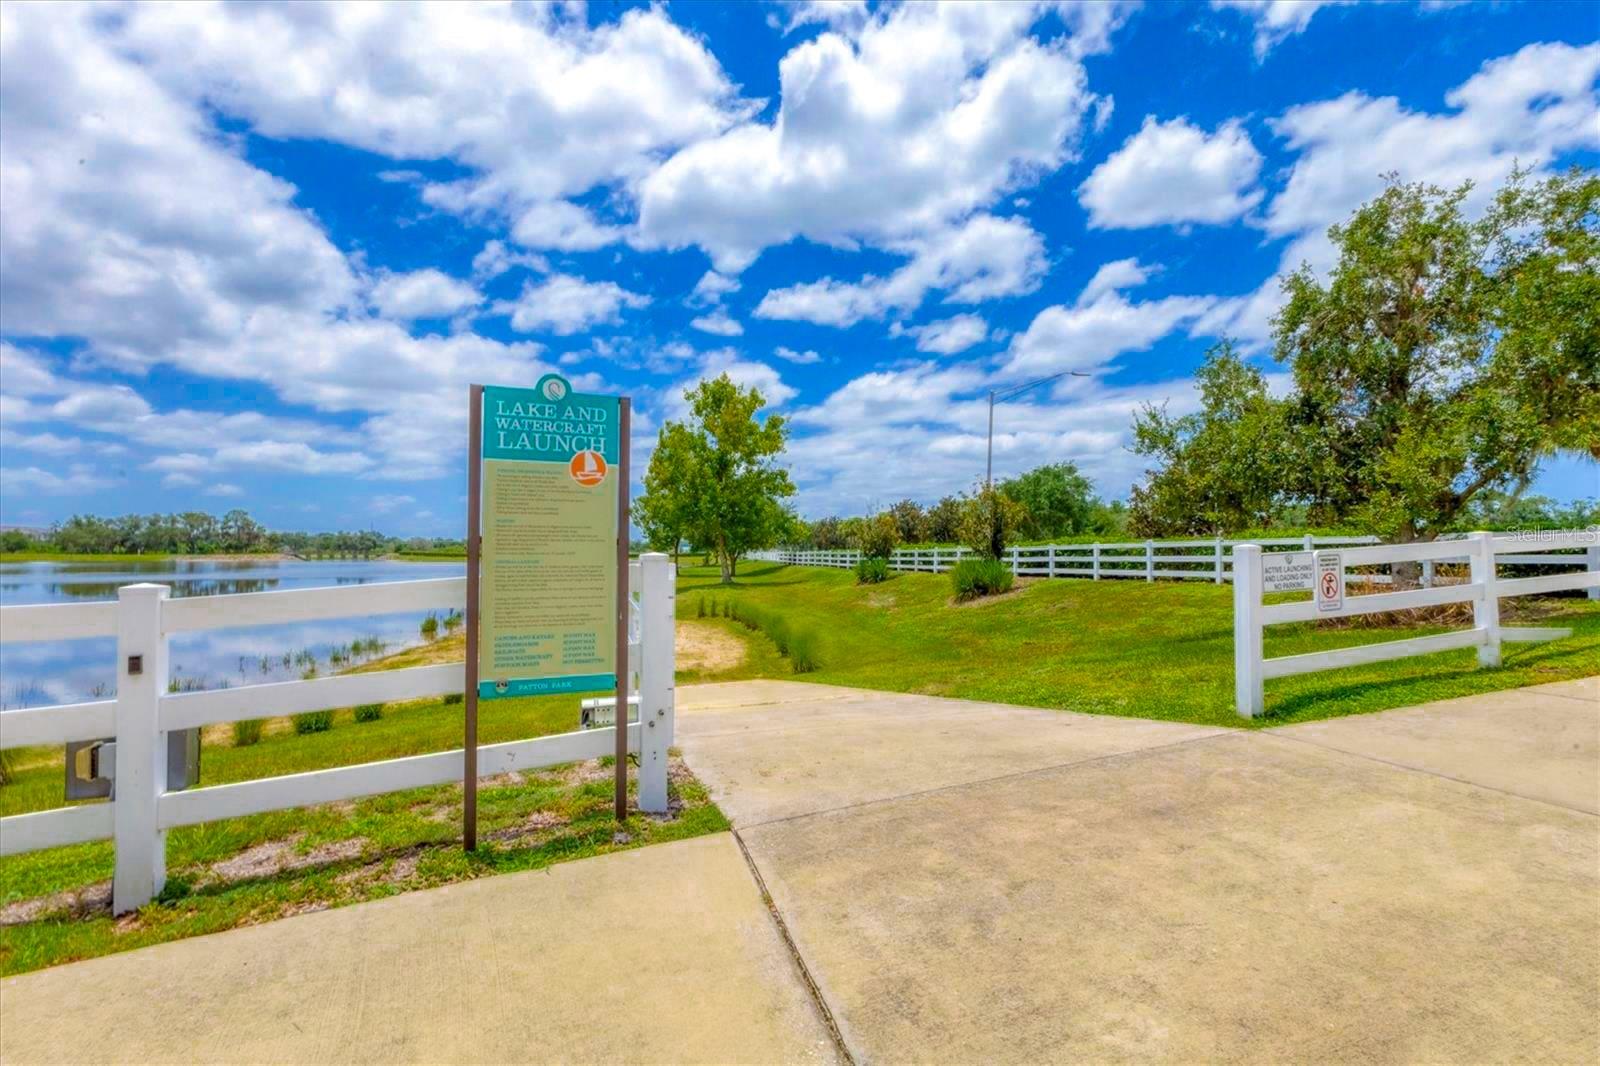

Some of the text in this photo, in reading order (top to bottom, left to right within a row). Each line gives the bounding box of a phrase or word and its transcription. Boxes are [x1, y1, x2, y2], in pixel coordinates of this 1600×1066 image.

[496, 401, 607, 422] LAKE AND
[495, 417, 606, 435] WATERCRAFT
[497, 431, 606, 454] LAUNCH
[1264, 566, 1282, 574] ACTIVE
[1283, 564, 1312, 573] LAUNCHING
[1276, 573, 1299, 581] LOADING
[1282, 581, 1304, 589] PARKING
[518, 681, 572, 691] PATTON PARK
